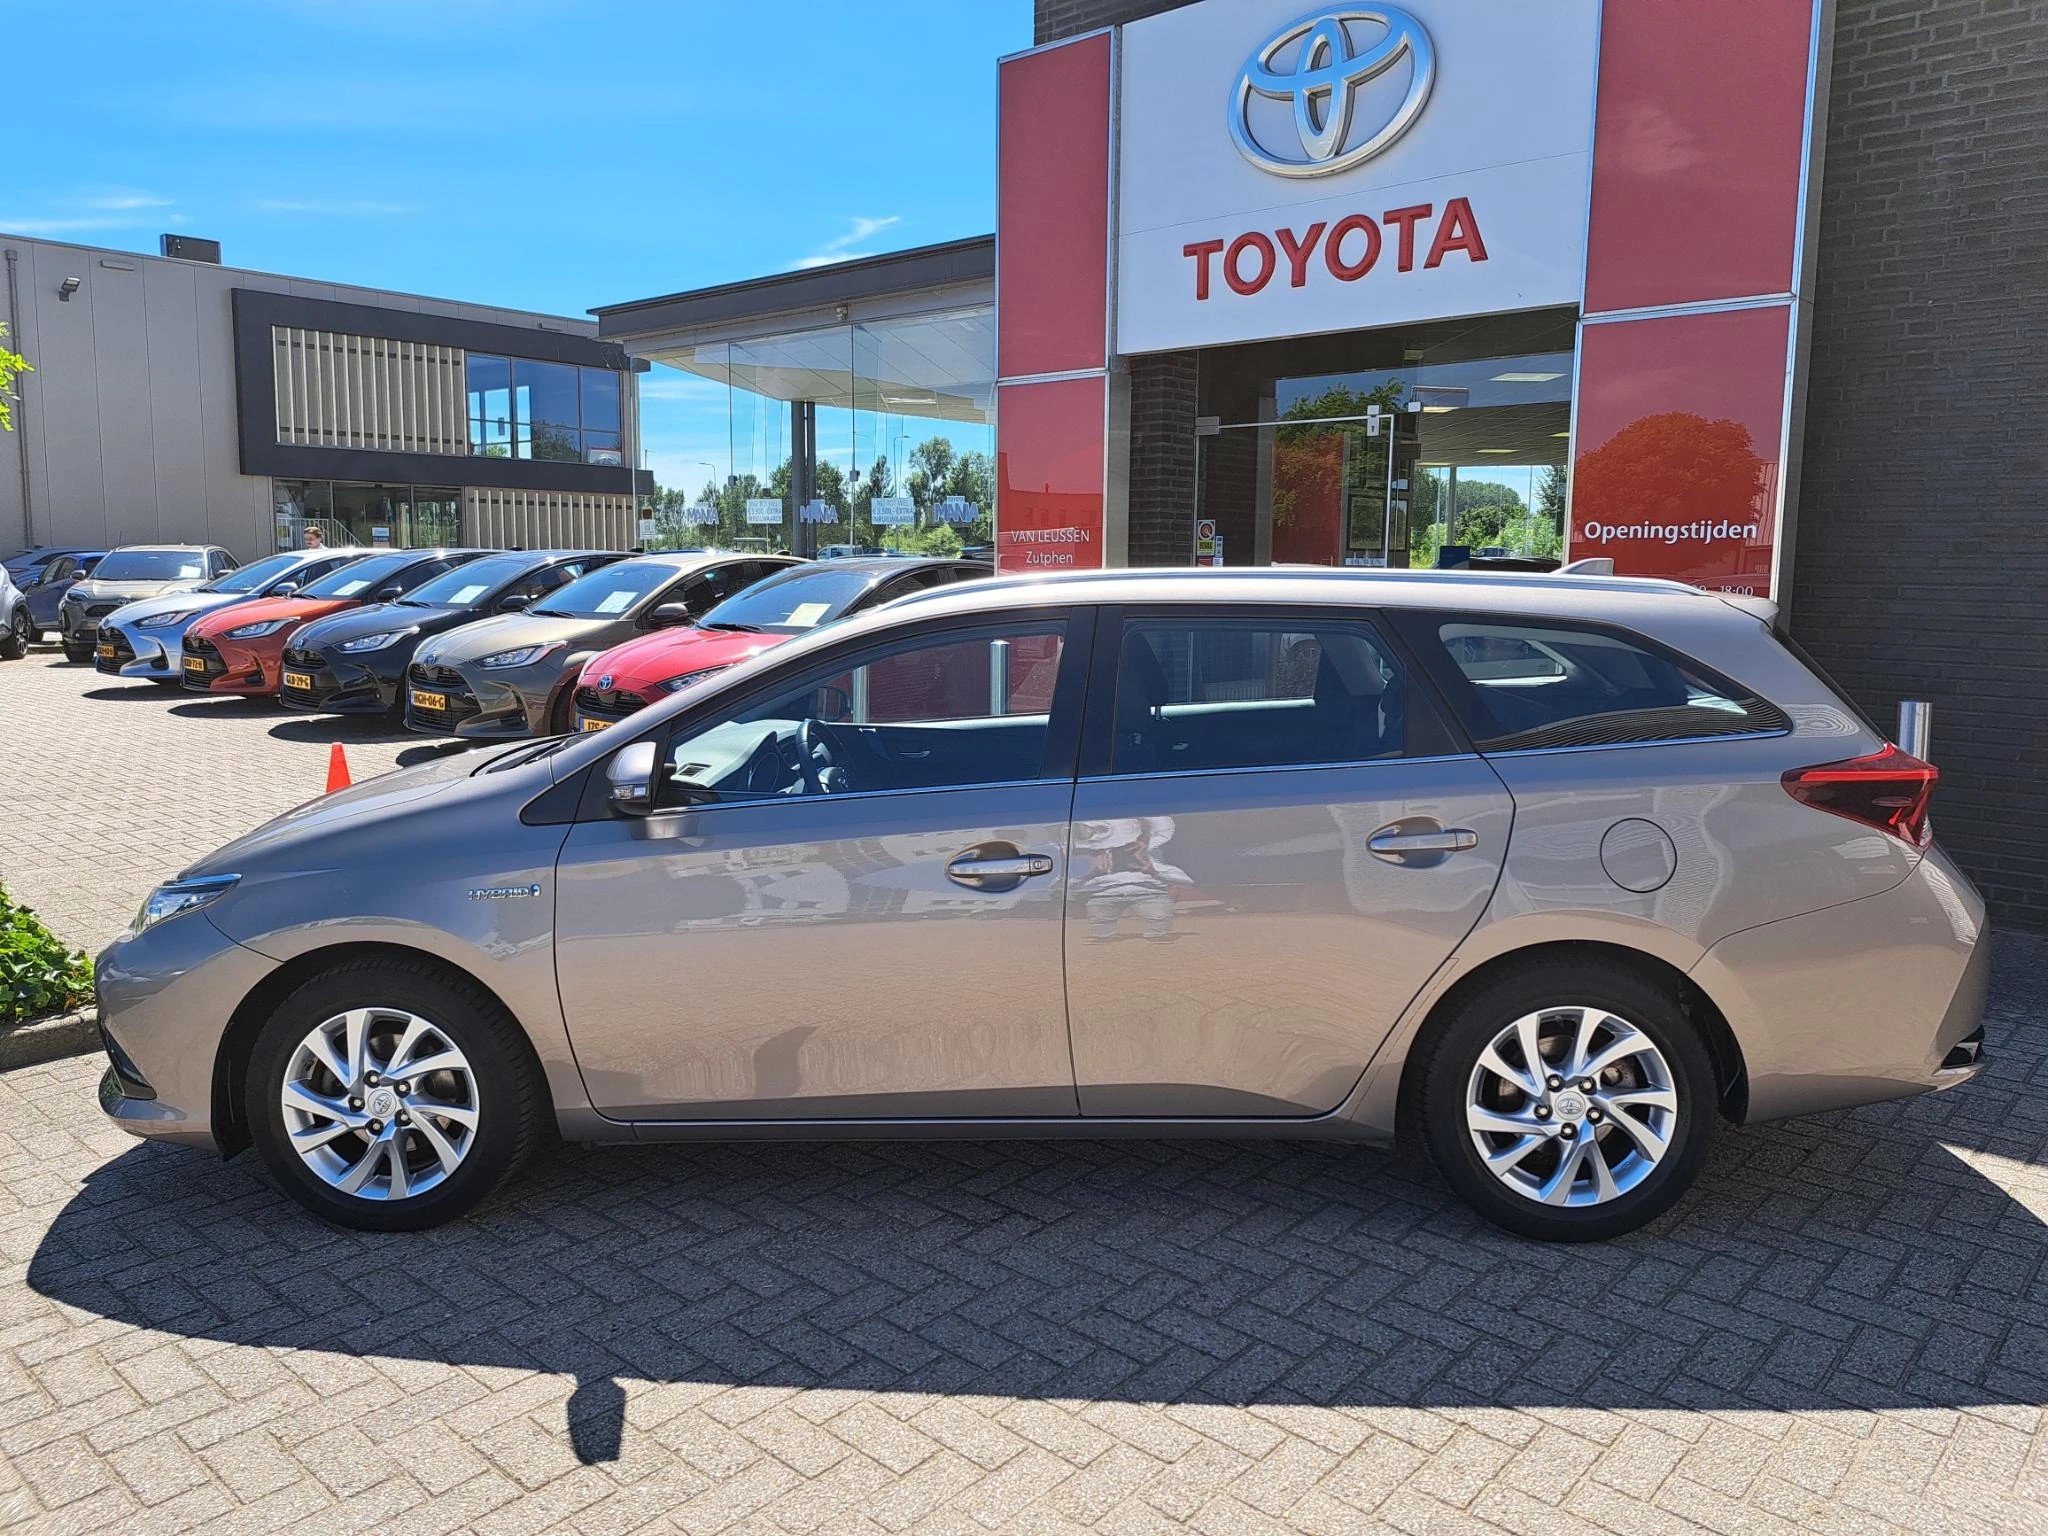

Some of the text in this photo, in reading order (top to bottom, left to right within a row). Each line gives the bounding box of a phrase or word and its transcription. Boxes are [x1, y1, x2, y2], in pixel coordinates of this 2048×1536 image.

[1183, 197, 1488, 300] TOYOTA
[935, 502, 980, 522] MANIA
[1011, 529, 1089, 543] VAN LEUSSEN
[1584, 520, 1758, 544] Openingstijden
[1026, 551, 1073, 566] Zutphen
[468, 887, 529, 901] HYBRID
